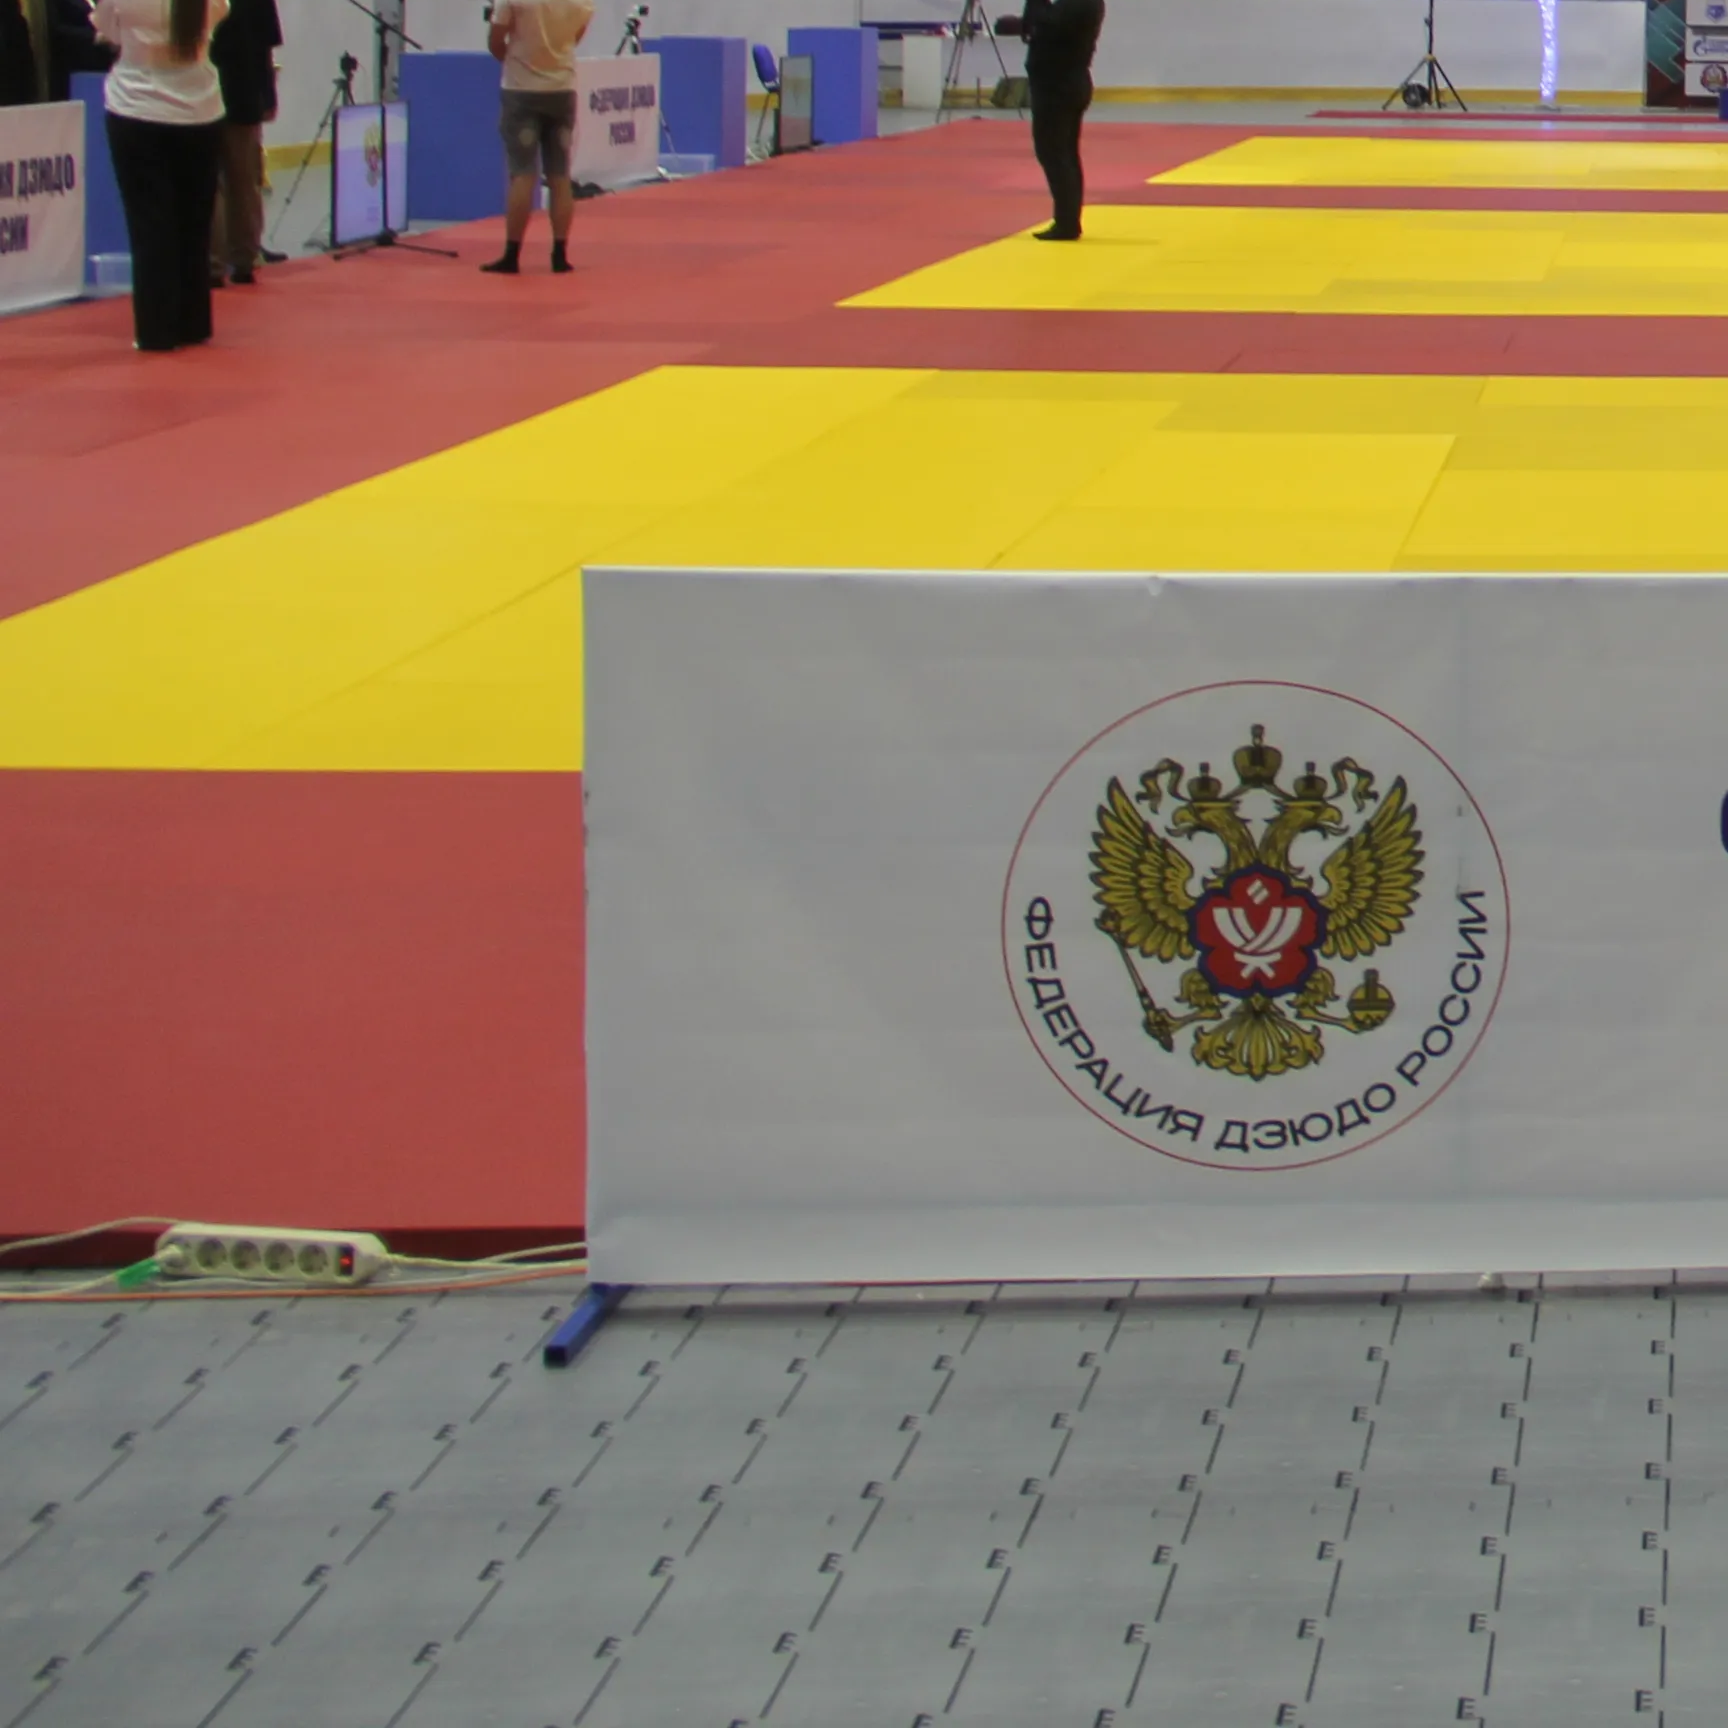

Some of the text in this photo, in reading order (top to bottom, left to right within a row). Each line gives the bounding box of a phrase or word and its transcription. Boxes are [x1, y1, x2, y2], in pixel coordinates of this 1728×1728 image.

[17, 153, 74, 201] ДЗЮДО
[1024, 889, 1488, 1153] ФЕДЕРАЦИЯ ДЗЮДО РОССИИ
